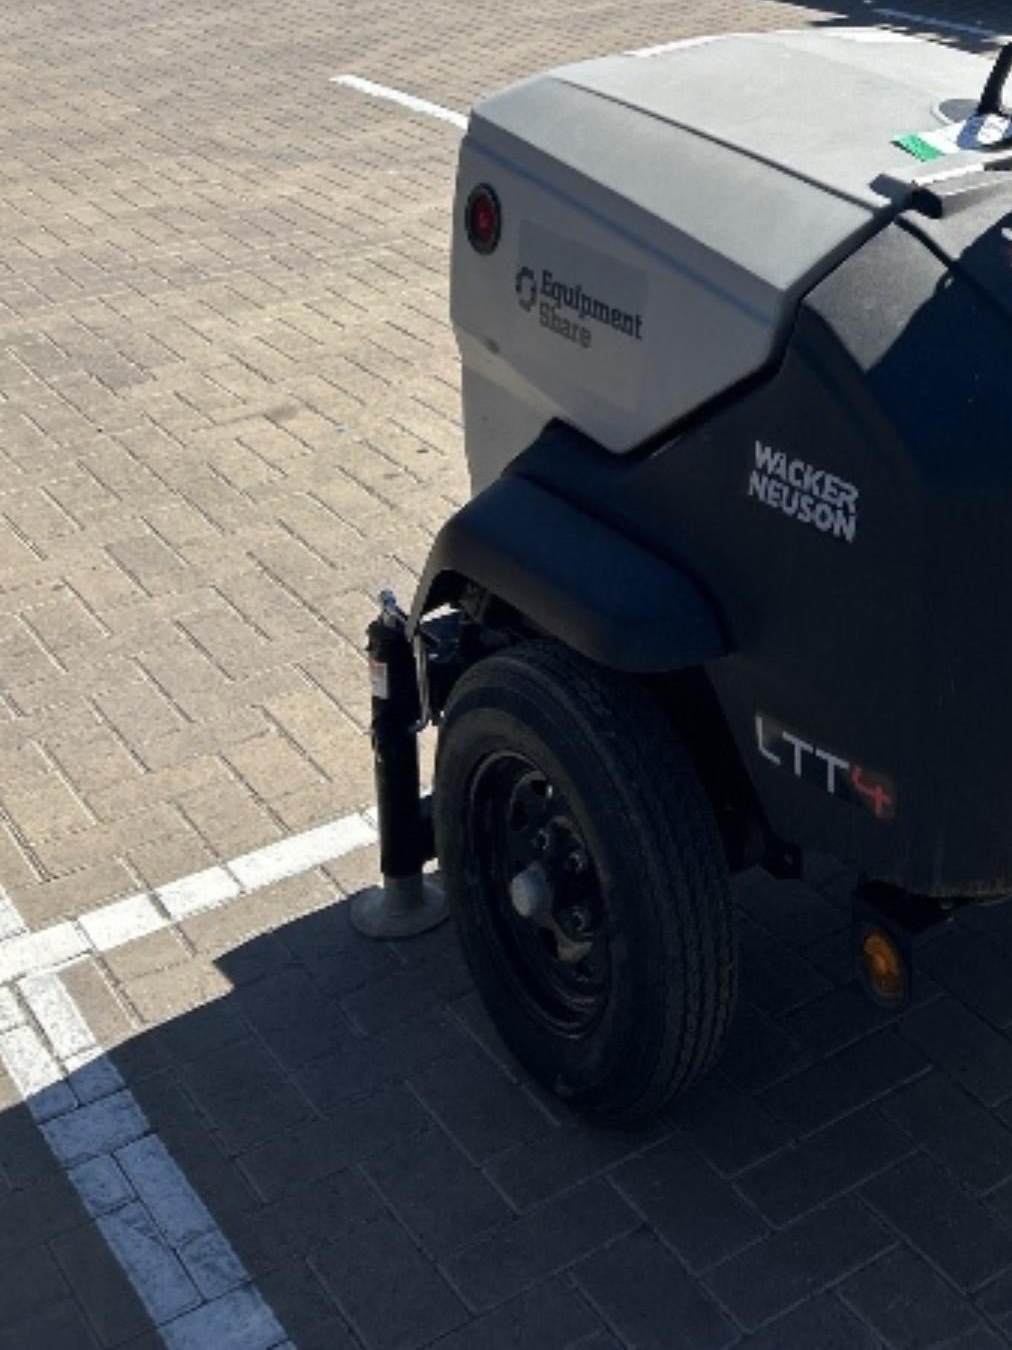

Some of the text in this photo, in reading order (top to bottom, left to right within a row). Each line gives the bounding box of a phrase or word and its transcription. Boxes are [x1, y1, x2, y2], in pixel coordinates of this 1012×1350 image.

[539, 303, 592, 349] Share
[540, 269, 643, 340] Equipment
[748, 470, 857, 543] NEUSON
[755, 440, 859, 511] WACKER
